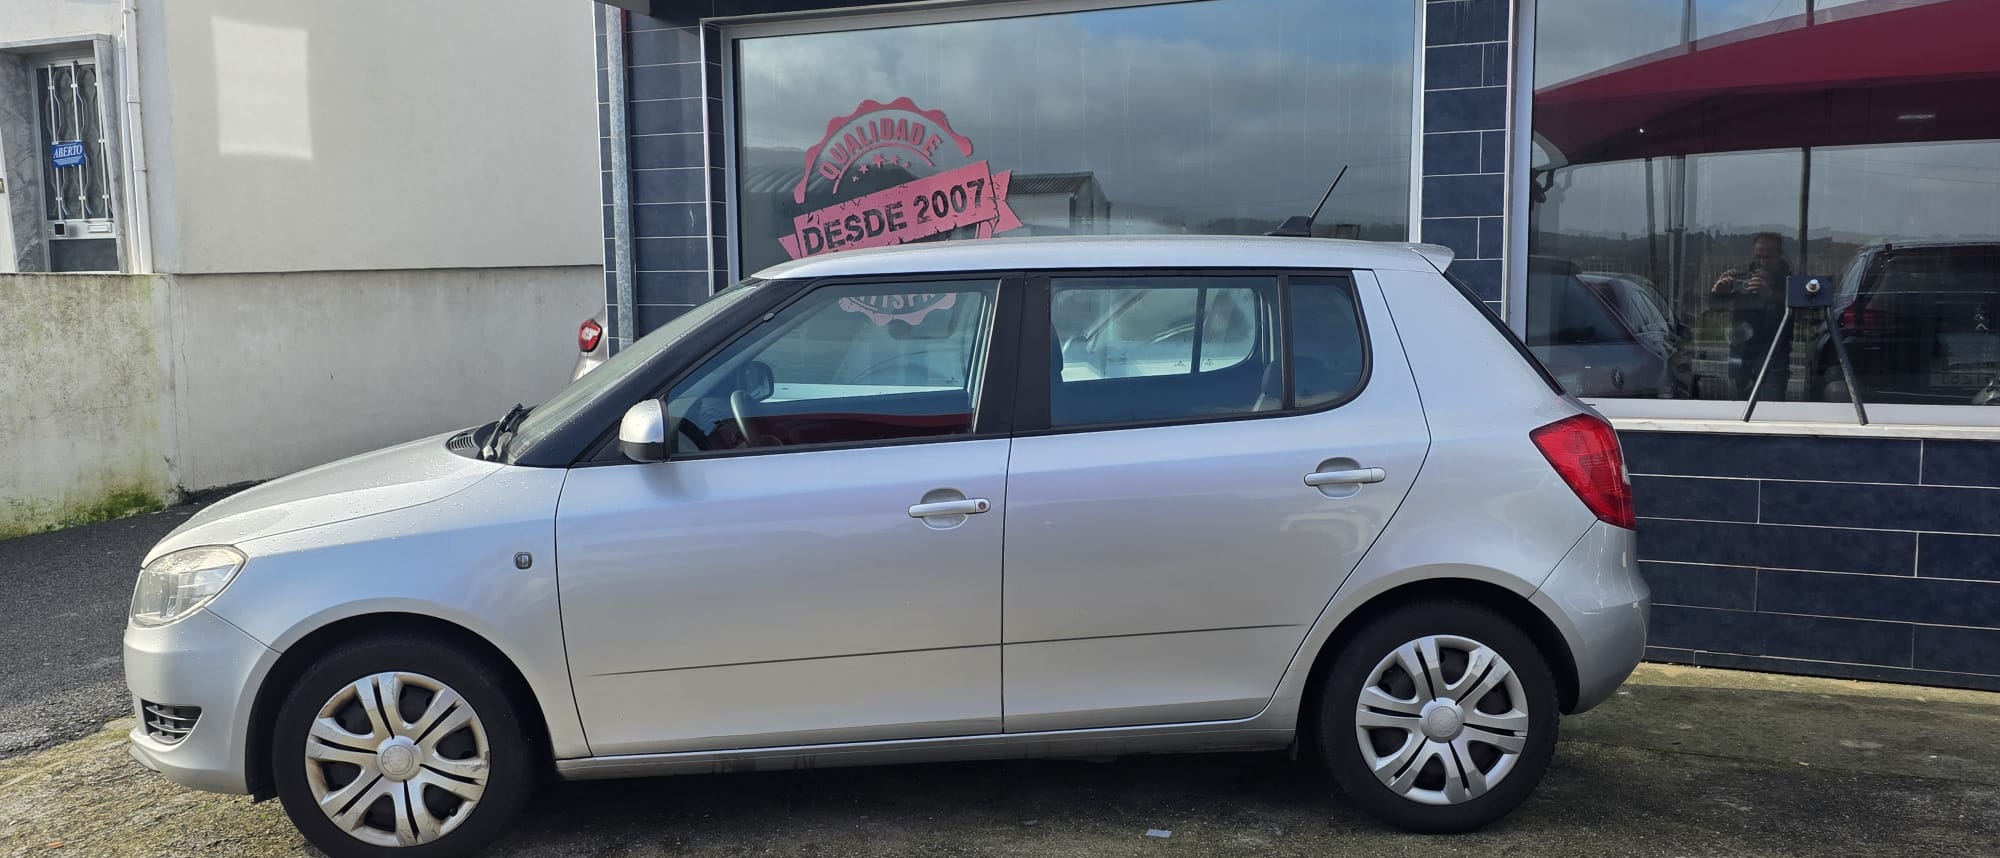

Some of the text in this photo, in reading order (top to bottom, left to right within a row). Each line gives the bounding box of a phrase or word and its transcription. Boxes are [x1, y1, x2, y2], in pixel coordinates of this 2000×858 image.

[53, 144, 83, 159] ABERTO
[818, 117, 943, 181] QUALIDADE
[802, 177, 986, 256] DESDE 2007
